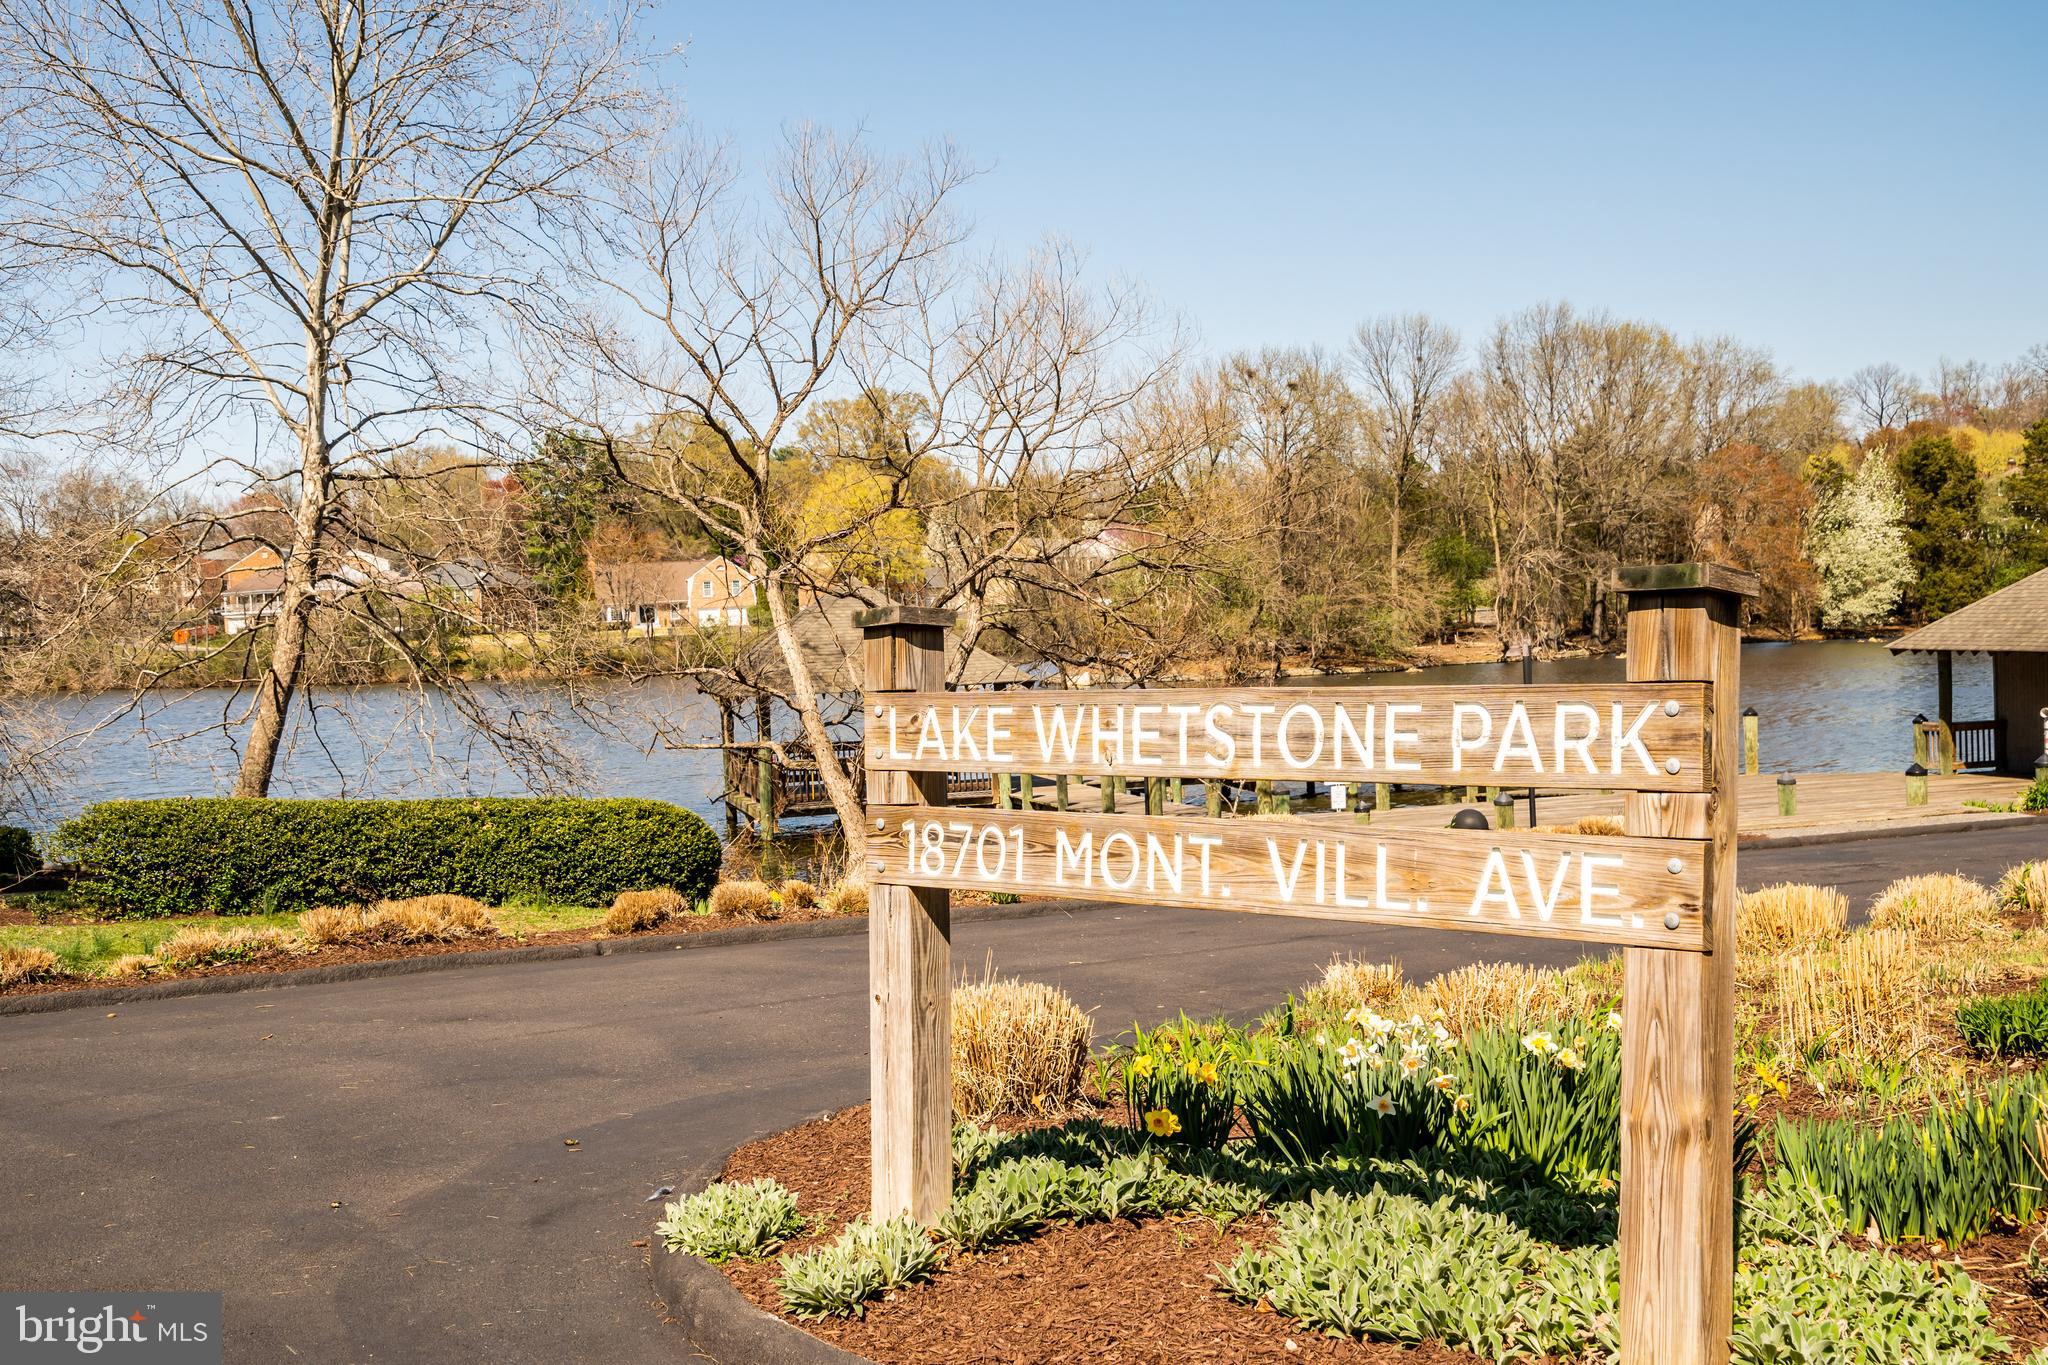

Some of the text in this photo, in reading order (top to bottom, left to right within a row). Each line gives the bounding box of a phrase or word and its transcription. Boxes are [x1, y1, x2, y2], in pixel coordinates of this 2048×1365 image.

[888, 700, 1660, 775] LAKE WHETSTONE PARK
[902, 819, 1644, 928] 18701 MONT. VILL. AVE.
